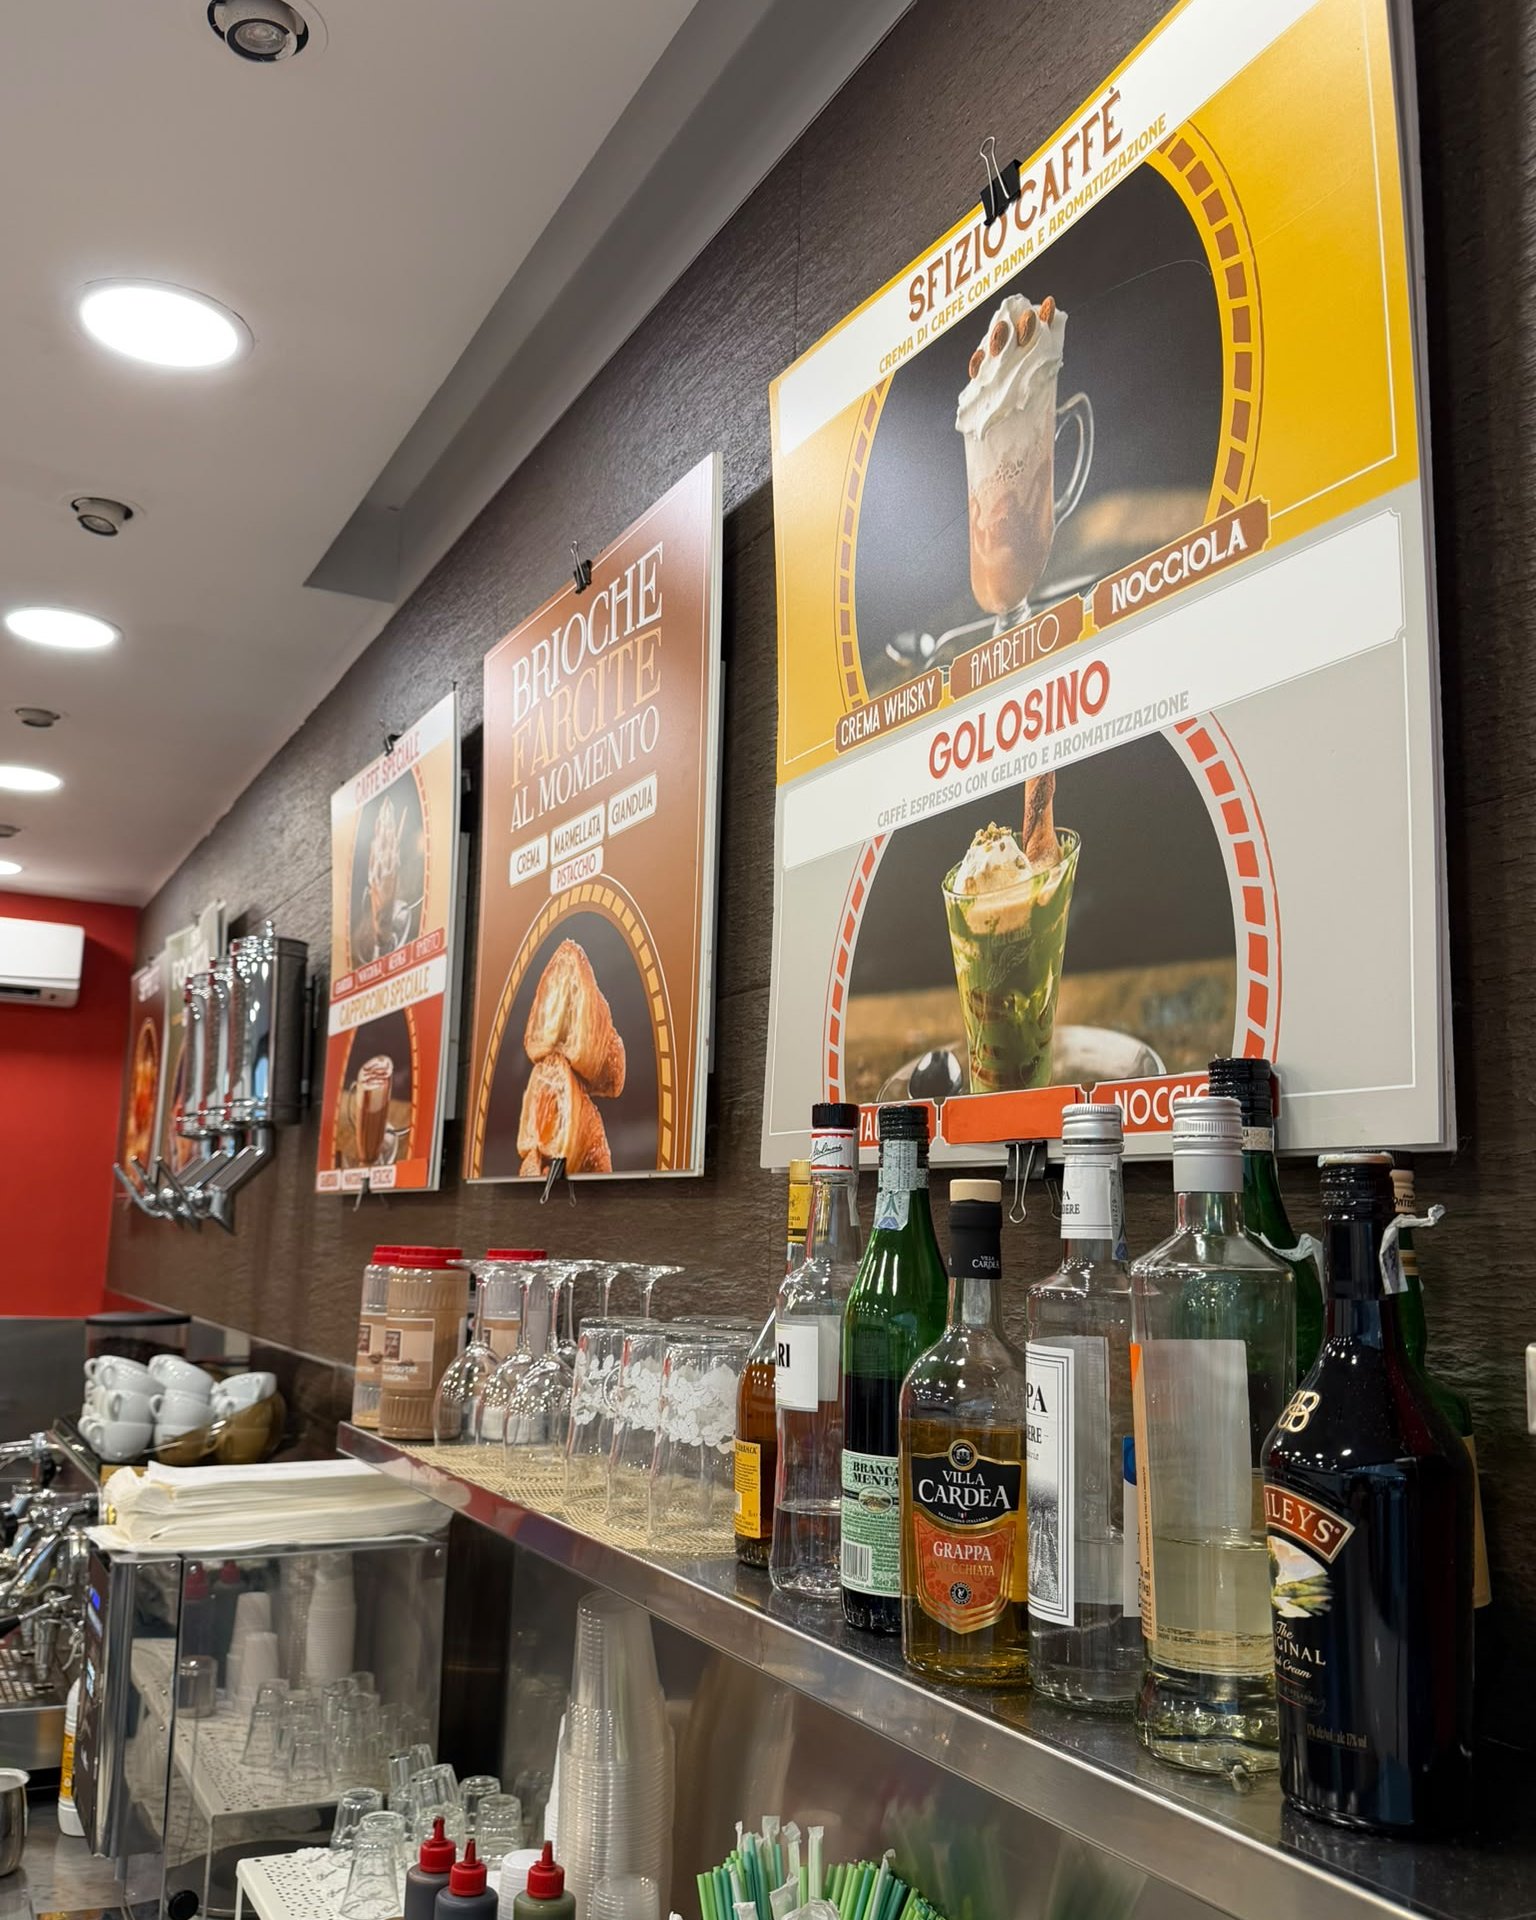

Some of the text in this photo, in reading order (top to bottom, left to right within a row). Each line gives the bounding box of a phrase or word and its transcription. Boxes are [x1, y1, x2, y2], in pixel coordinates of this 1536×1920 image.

[1014, 86, 1123, 231] CAFFÈ
[879, 113, 1167, 374] CREMA DI CAFFÈ CON PANNA E AROMATIZZAZIONE
[1111, 518, 1248, 615] NOCCIOLA
[512, 541, 663, 728] BRIOCHE
[970, 614, 1059, 689] AMARETTO
[512, 627, 662, 789] FARCITE
[841, 676, 935, 748] CREMA WHISKY
[929, 660, 1110, 779] GOLOSINO
[511, 705, 660, 833] AL MOMENTO
[877, 690, 1189, 828] CAFFÈ ESPRESSO CON GELATO E AROMATIZZAZIONE
[612, 784, 653, 825] GIANDUIA
[554, 814, 601, 856] MARMELLATA
[517, 845, 540, 875] CREMA
[556, 853, 596, 889] PISTACCHIO
[1115, 1083, 1209, 1127] NOCC
[853, 1471, 899, 1487] MENTA
[918, 1478, 1012, 1511] CARDEA
[942, 1470, 985, 1486] VILLA
[1265, 1492, 1334, 1543] ILEYS
[933, 1541, 993, 1561] GRAPPA
[1276, 1621, 1294, 1640] The
[1276, 1636, 1326, 1666] GINAL
[1283, 1659, 1312, 1678] Cream
